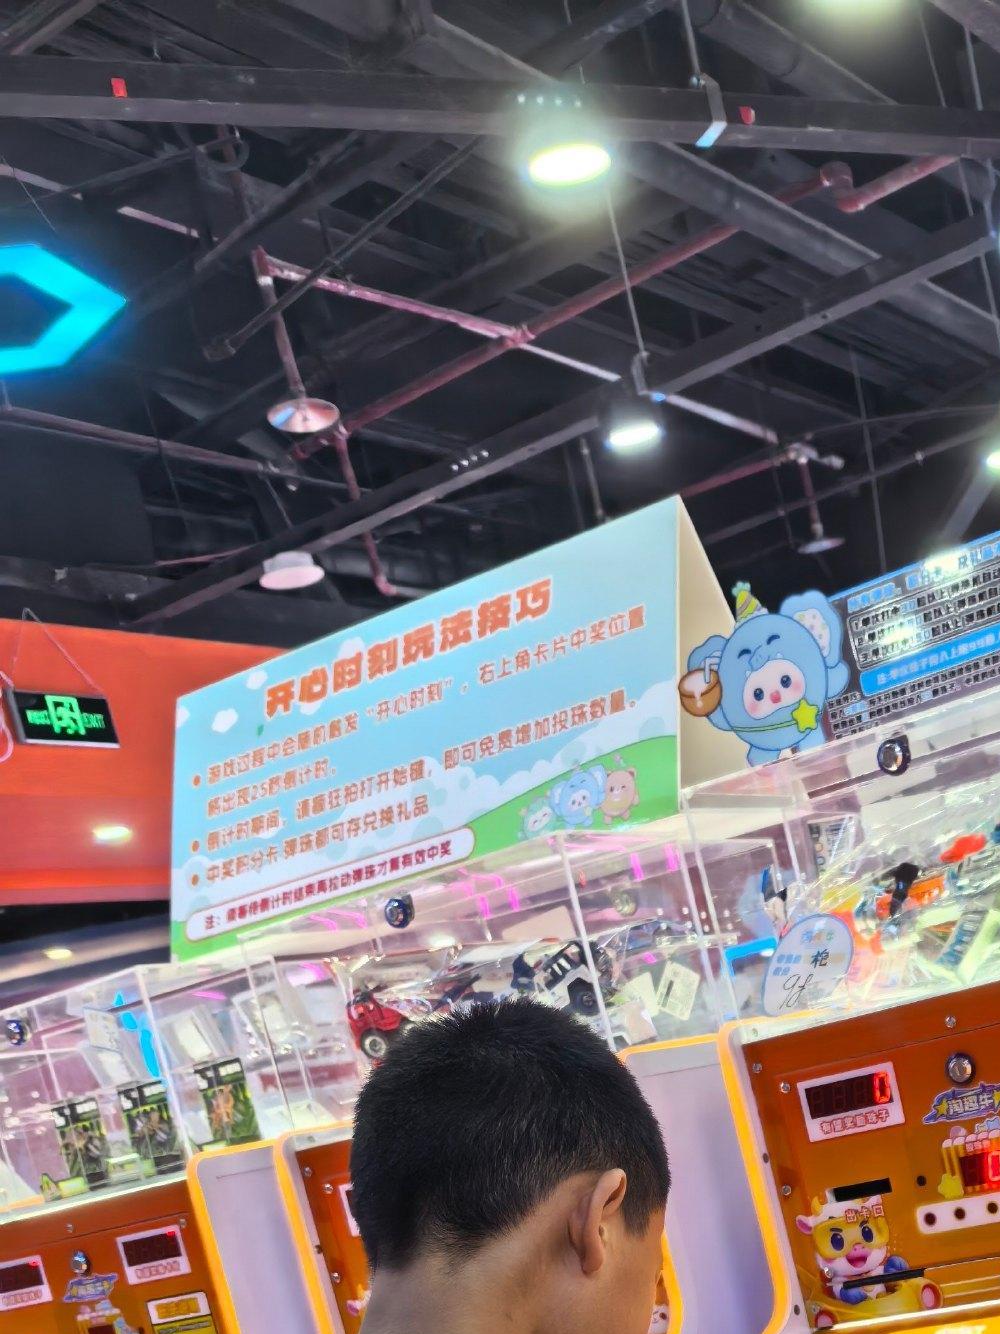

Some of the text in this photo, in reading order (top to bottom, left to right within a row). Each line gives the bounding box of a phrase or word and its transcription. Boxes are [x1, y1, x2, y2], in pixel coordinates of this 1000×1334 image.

[266, 577, 552, 720] 开心时刻玩法技巧
[845, 1204, 884, 1223] 出卡口
